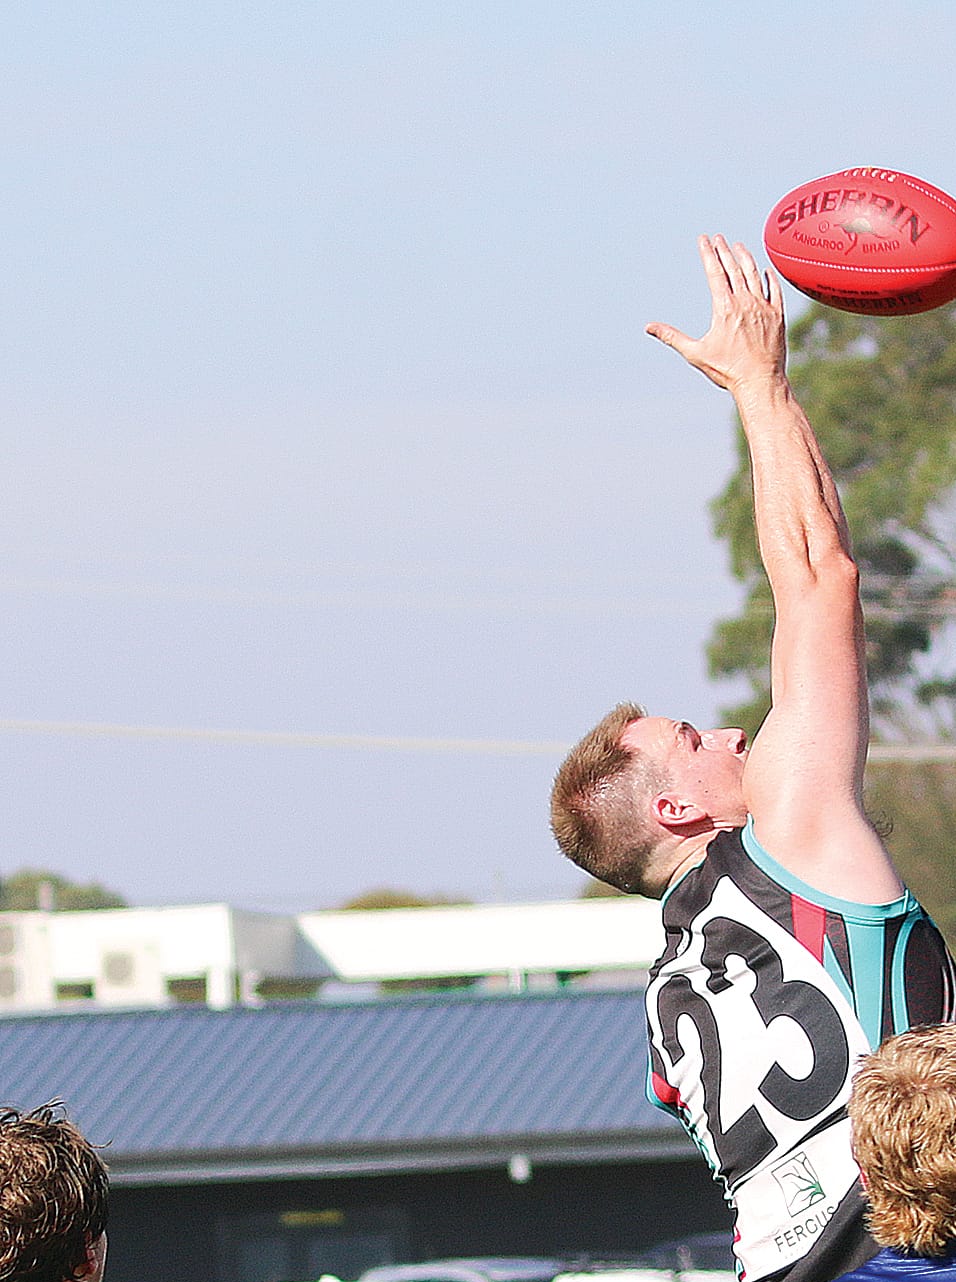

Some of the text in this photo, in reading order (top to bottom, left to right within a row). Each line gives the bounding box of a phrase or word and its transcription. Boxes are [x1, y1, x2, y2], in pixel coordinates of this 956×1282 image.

[777, 189, 931, 247] SHERRIN
[792, 230, 899, 254] KANGAROO BRAND
[657, 916, 849, 1181] 23
